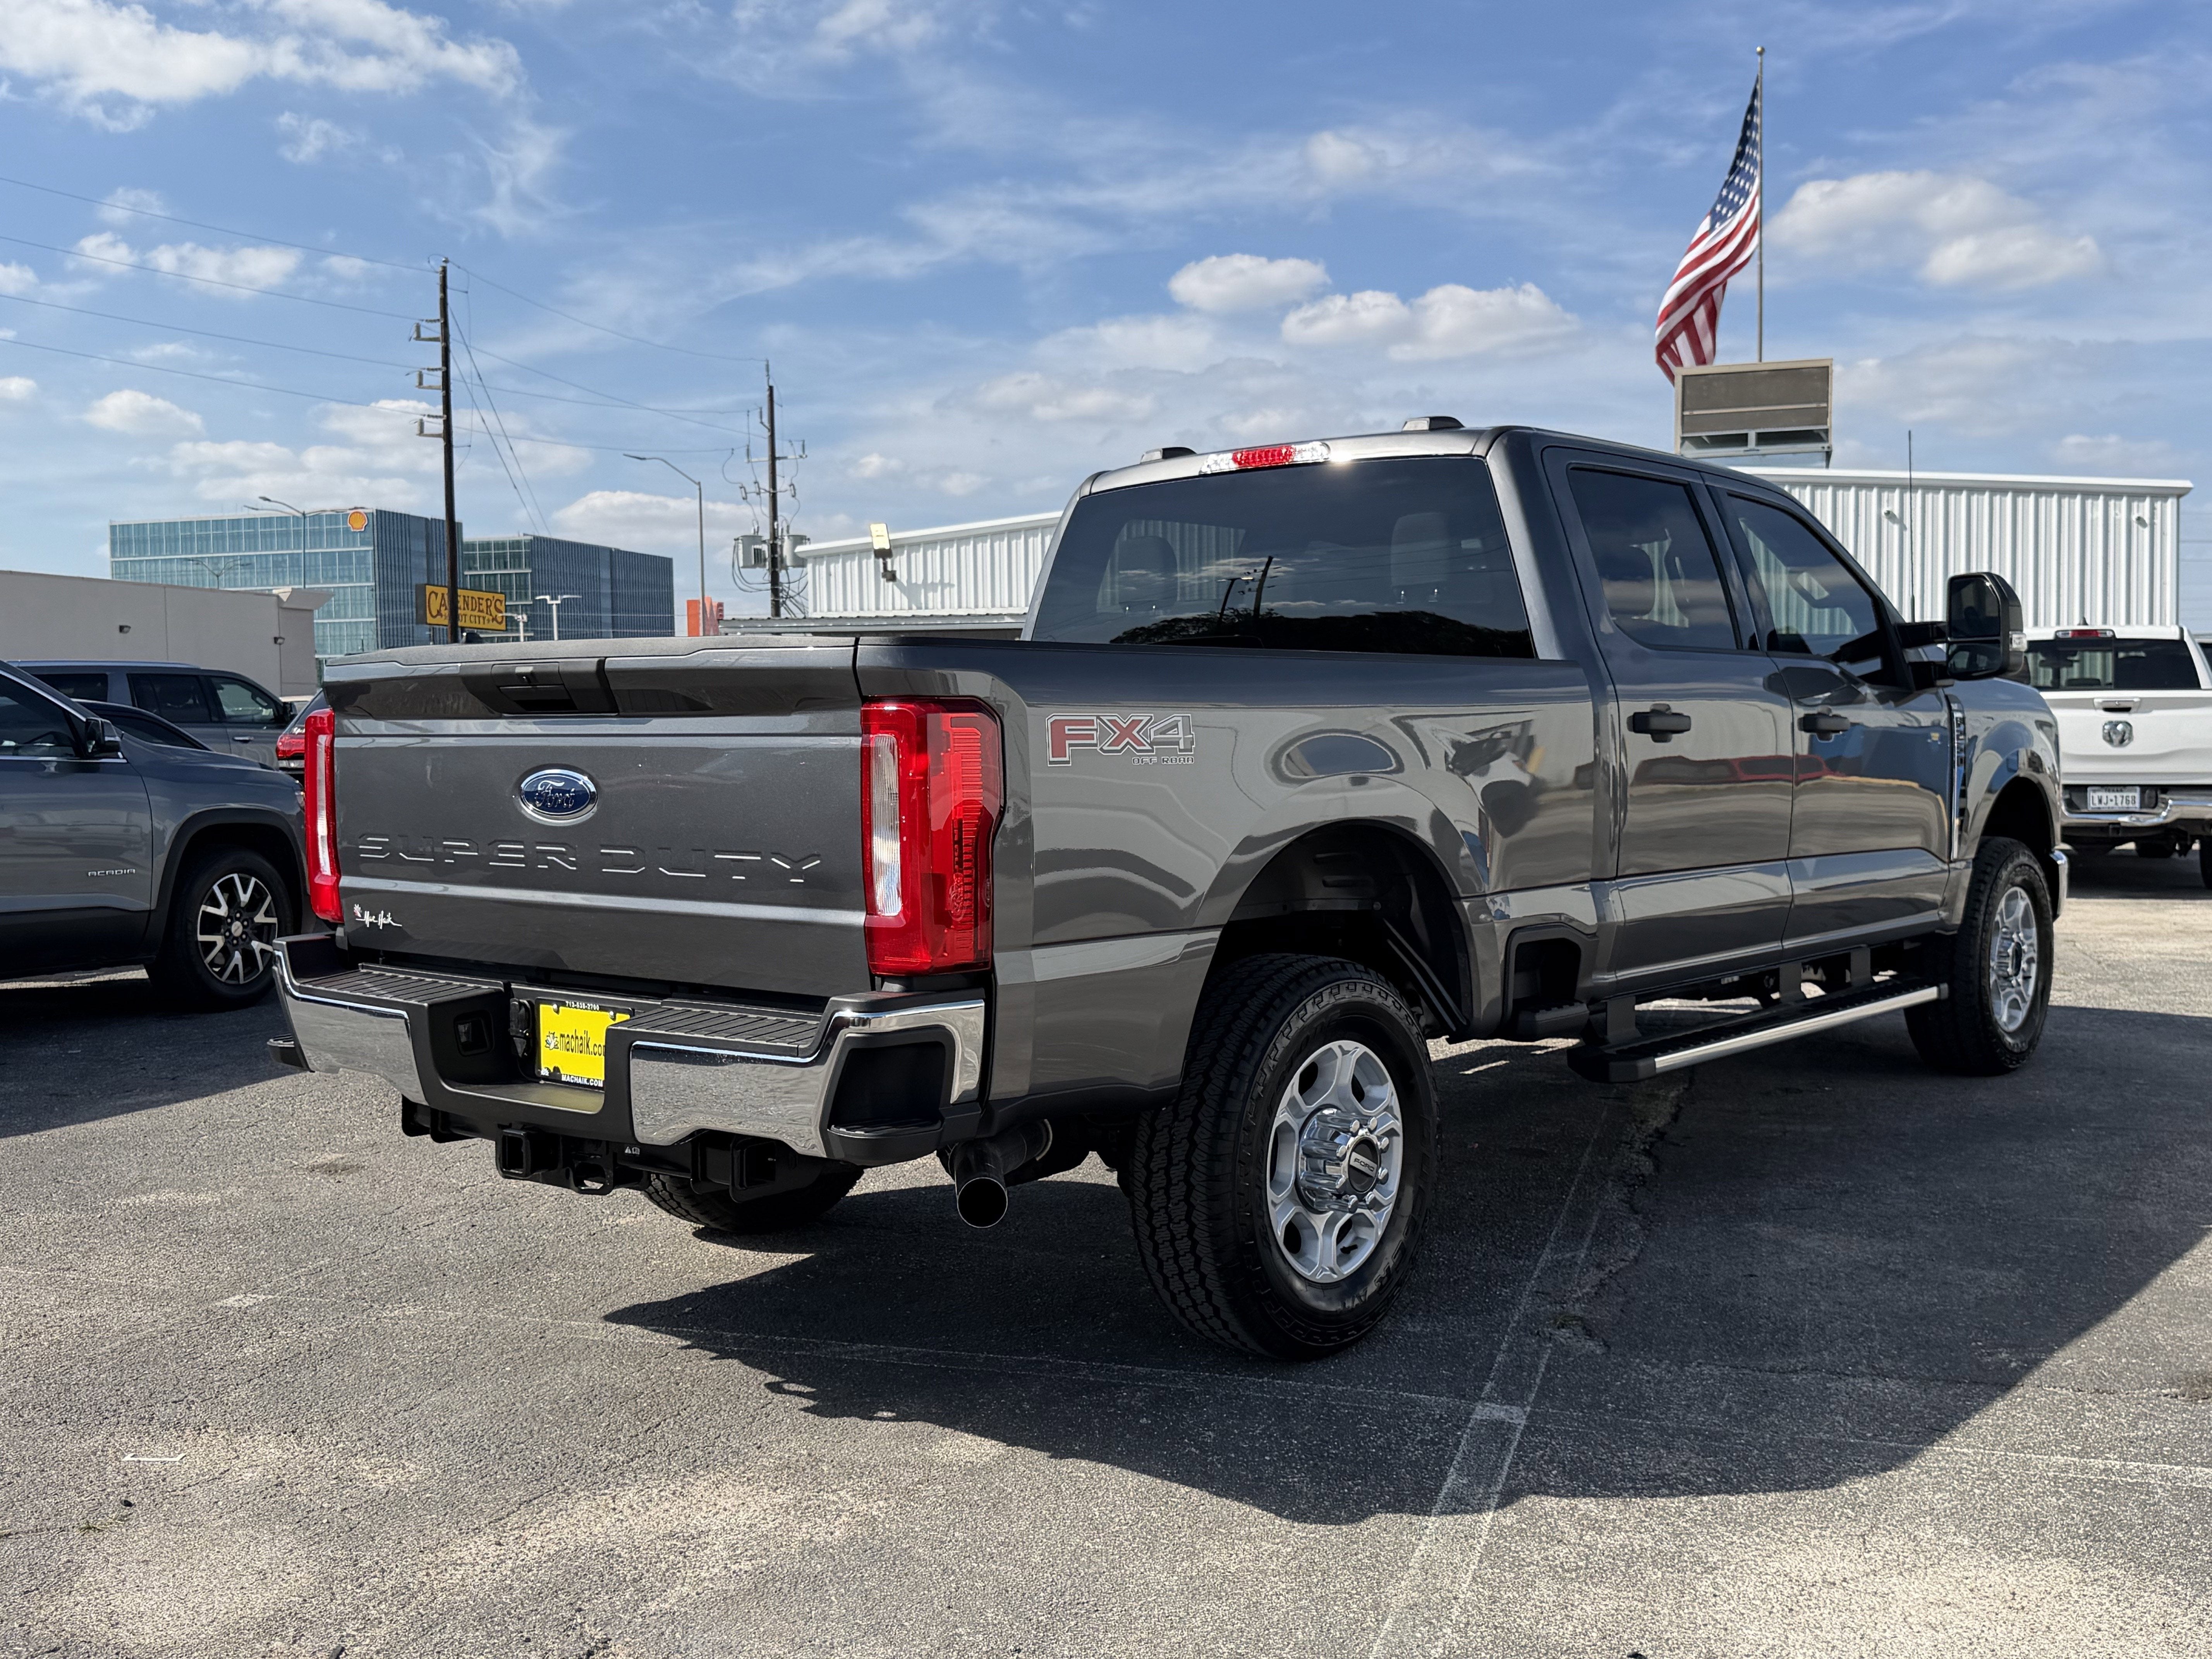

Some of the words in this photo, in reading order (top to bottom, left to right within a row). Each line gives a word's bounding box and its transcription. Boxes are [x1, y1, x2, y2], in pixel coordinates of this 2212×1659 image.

[428, 591, 503, 625] CANDER'S
[469, 615, 486, 625] CITY
[1046, 713, 1195, 766] FX4
[1132, 756, 1158, 765] OFF
[1161, 756, 1194, 764] ROAD
[534, 780, 575, 808] Ford
[359, 833, 577, 870] SUPER
[599, 844, 821, 882] DUTY
[88, 869, 136, 877] ACADIA
[561, 1074, 603, 1087] MACHAIK.COM
[1354, 1158, 1375, 1172] FORD
